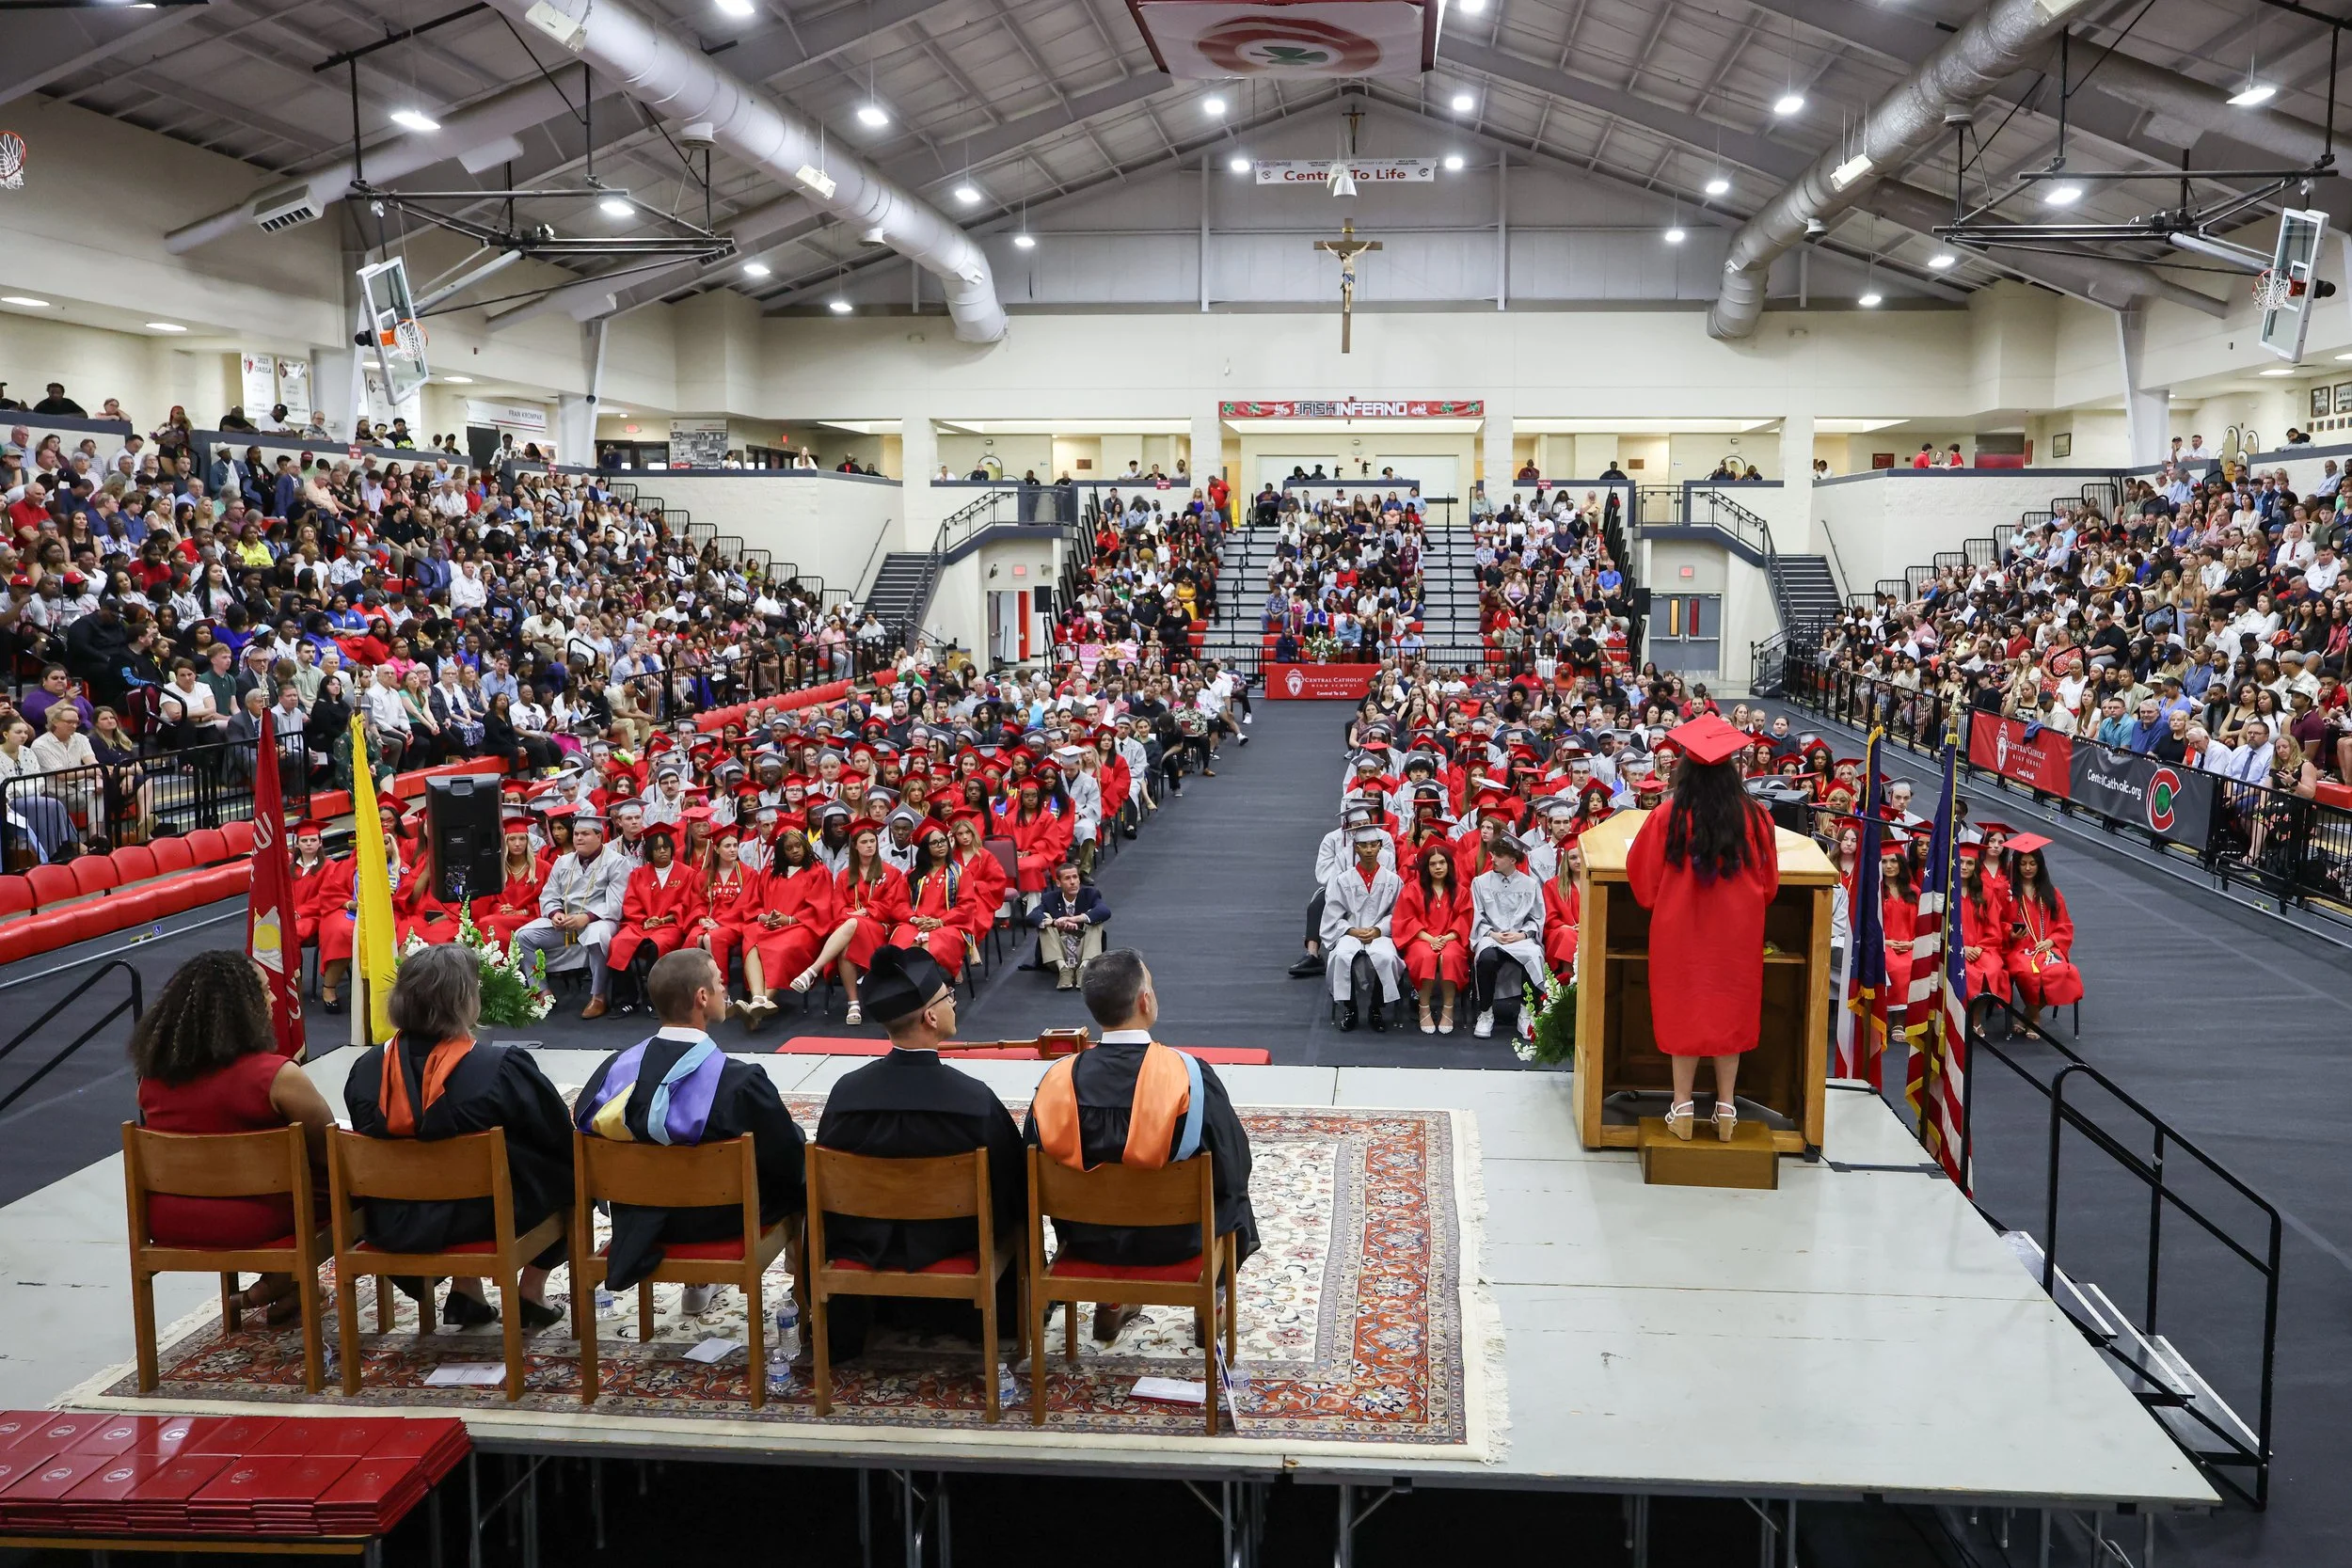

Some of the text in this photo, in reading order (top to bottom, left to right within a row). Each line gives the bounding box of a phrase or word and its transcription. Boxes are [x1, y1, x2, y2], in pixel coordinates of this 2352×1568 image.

[1284, 168, 1406, 181] Centr To Life
[508, 409, 521, 418] FRAN
[1299, 403, 1336, 415] IRISH
[1336, 402, 1407, 416] INFERNO
[2008, 740, 2027, 753] CENTRAL
